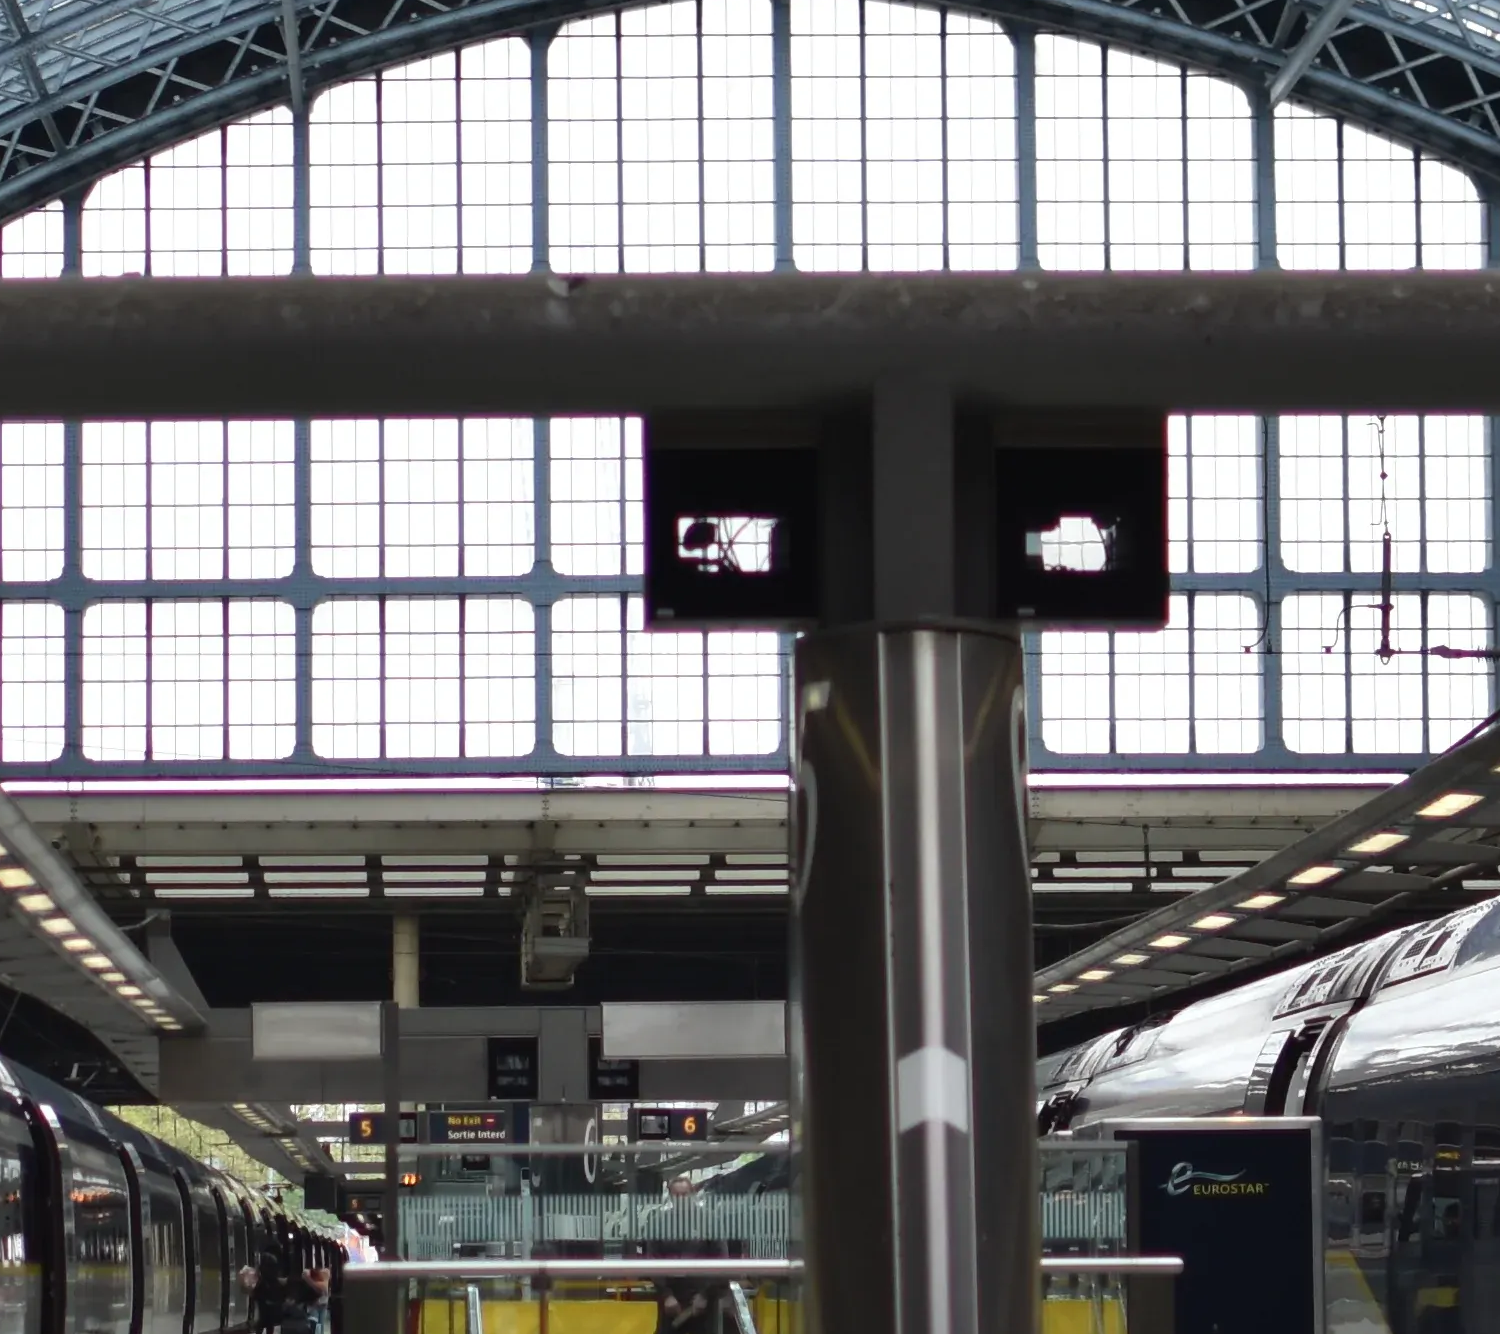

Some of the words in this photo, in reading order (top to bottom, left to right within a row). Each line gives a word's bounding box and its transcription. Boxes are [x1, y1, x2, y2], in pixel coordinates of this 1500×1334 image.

[448, 1116, 462, 1125] No
[464, 1116, 482, 1125] Exit
[683, 1117, 696, 1134] 6
[360, 1119, 373, 1137] 5
[448, 1130, 476, 1139] Sortie
[1193, 1183, 1265, 1195] EUROSTAR
